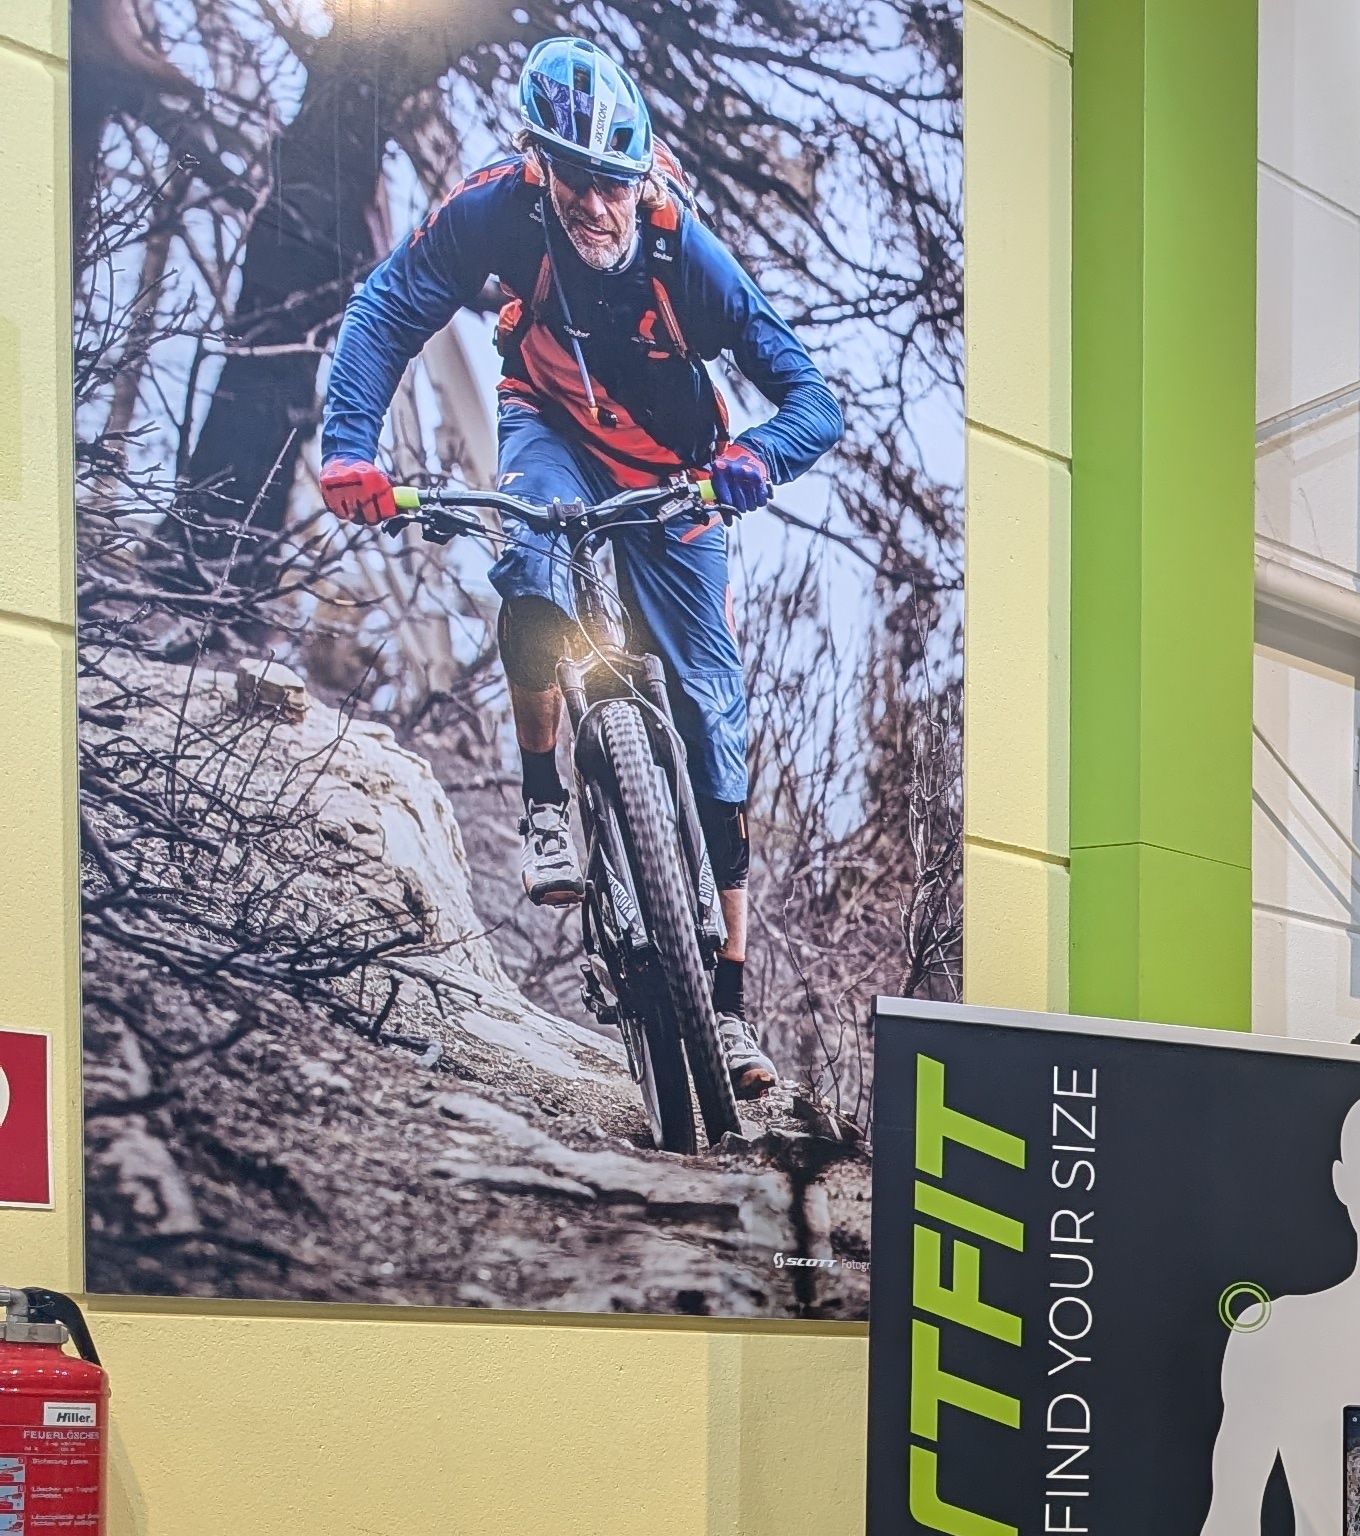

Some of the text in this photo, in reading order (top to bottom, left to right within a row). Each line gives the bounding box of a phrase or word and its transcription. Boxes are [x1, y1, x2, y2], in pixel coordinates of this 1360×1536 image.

[784, 1257, 838, 1268] SCOTT
[1044, 1065, 1098, 1534] FIND YOUR SIZE
